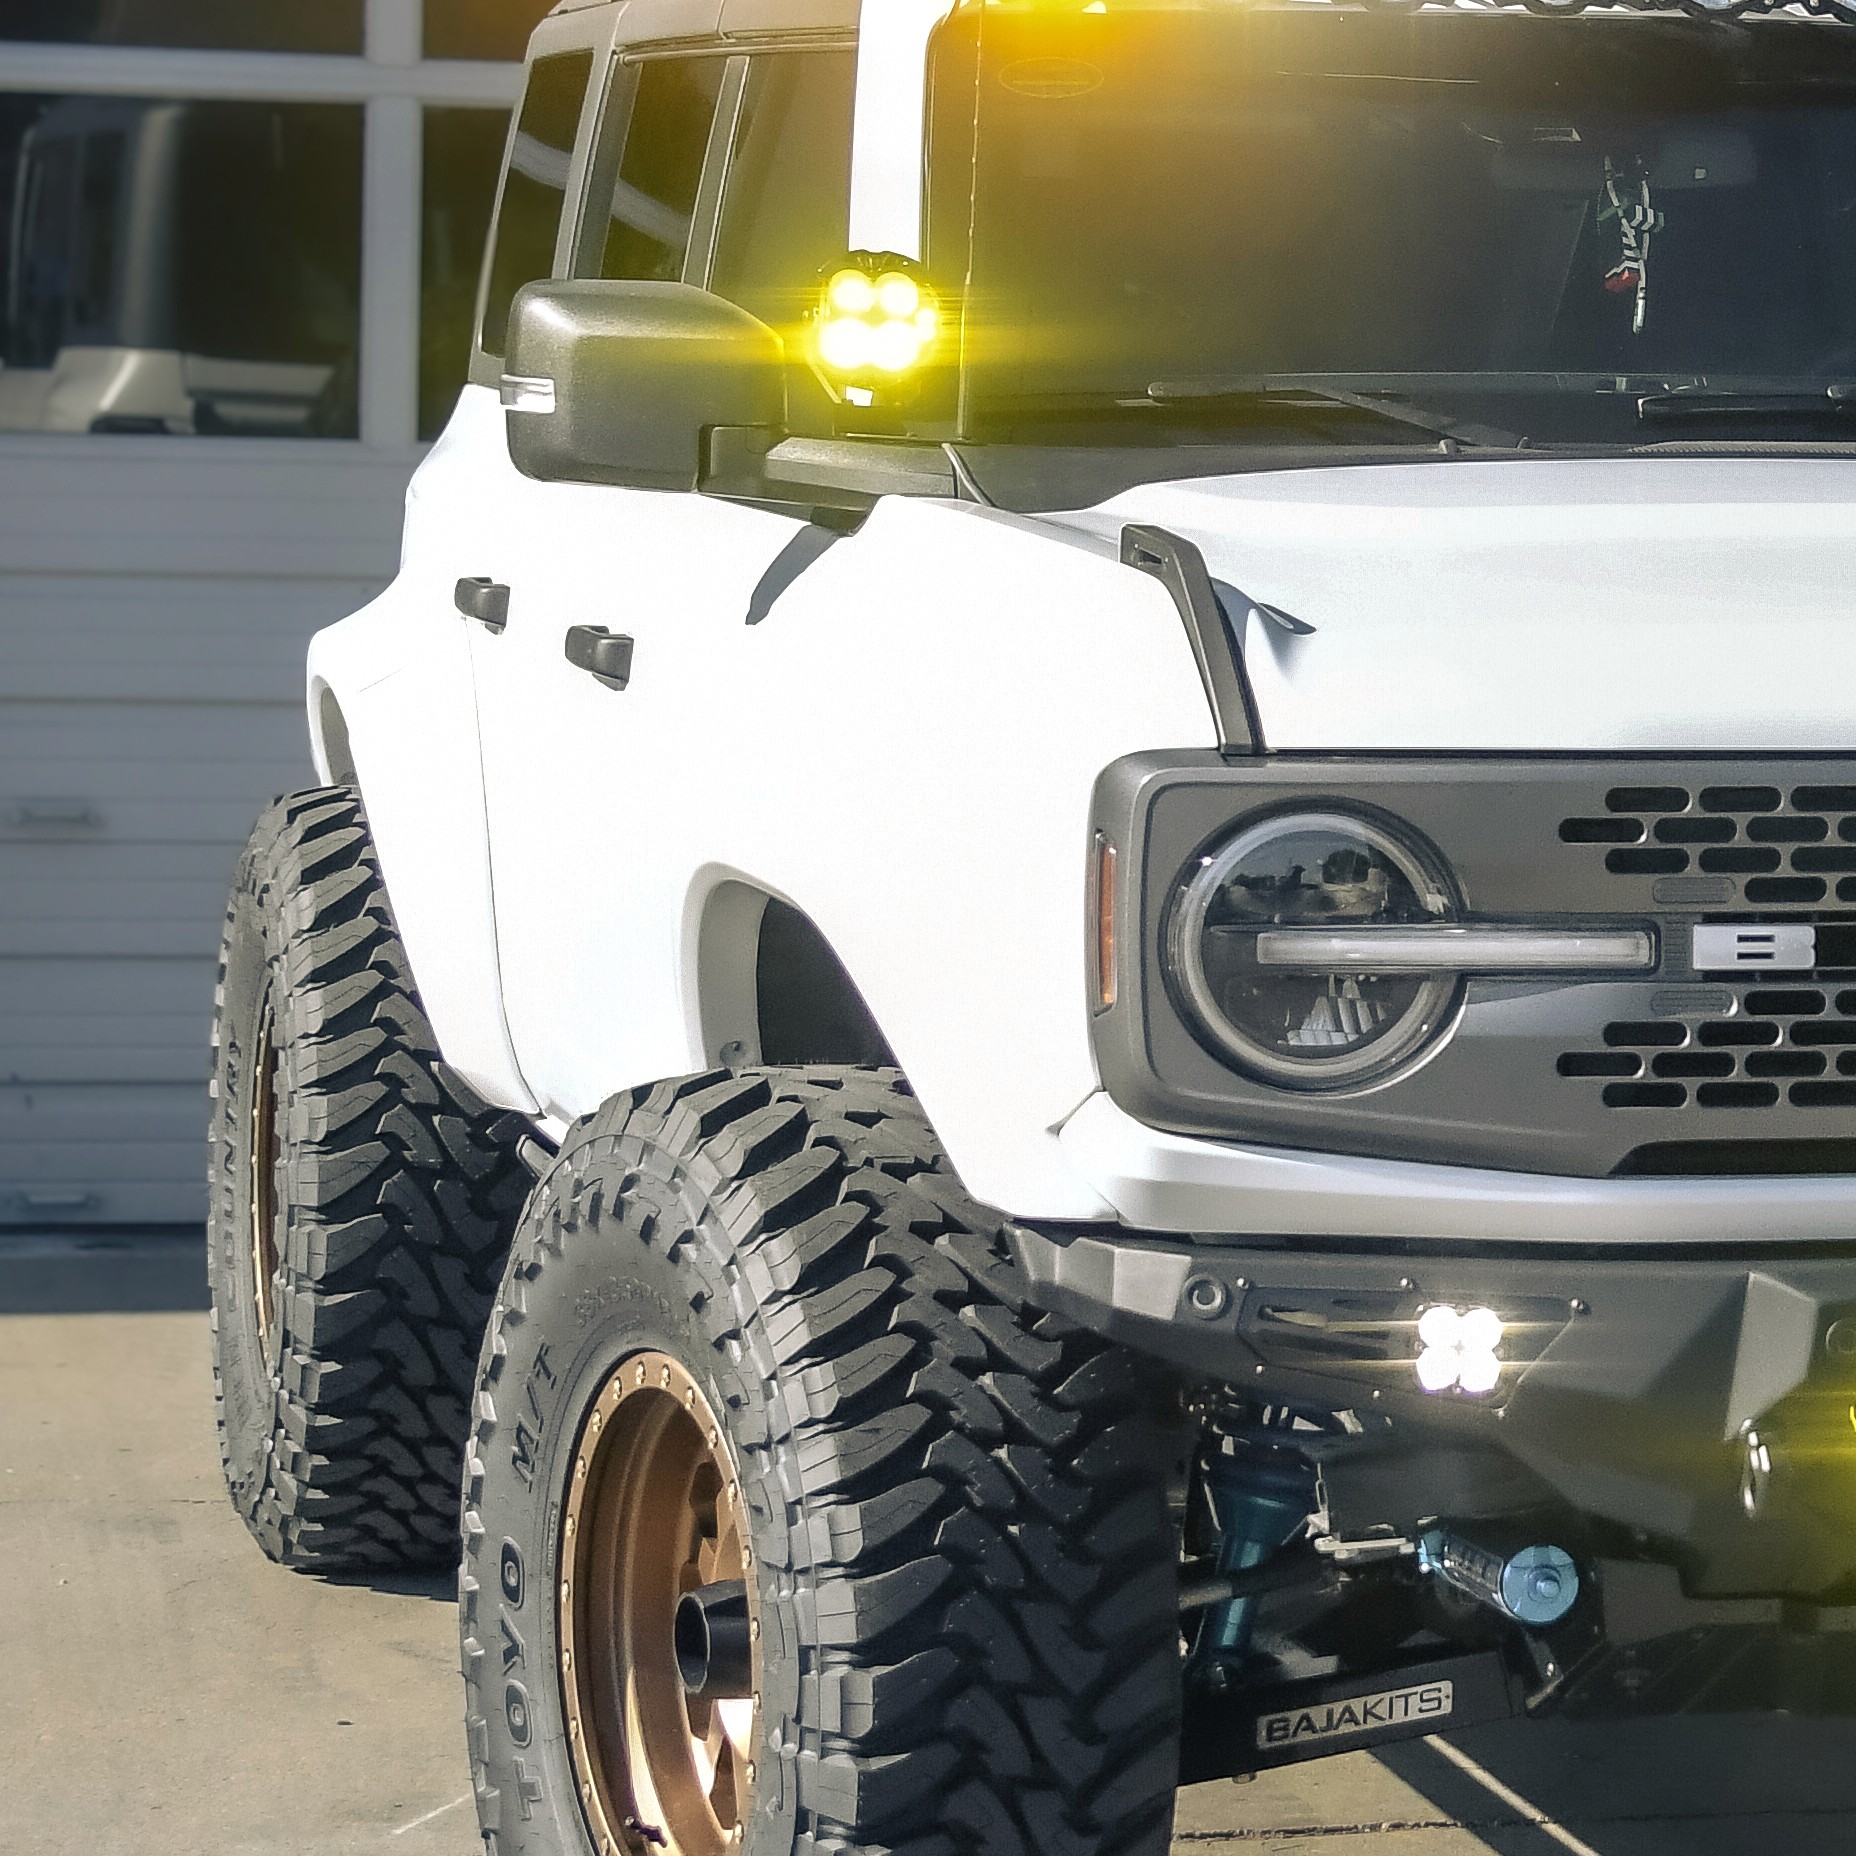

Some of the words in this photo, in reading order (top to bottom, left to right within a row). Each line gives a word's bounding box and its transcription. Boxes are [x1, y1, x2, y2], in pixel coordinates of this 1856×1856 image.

[511, 1342, 558, 1494] M/T
[499, 1535, 544, 1821] TOYO
[1266, 1686, 1443, 1743] BAJAKITS
